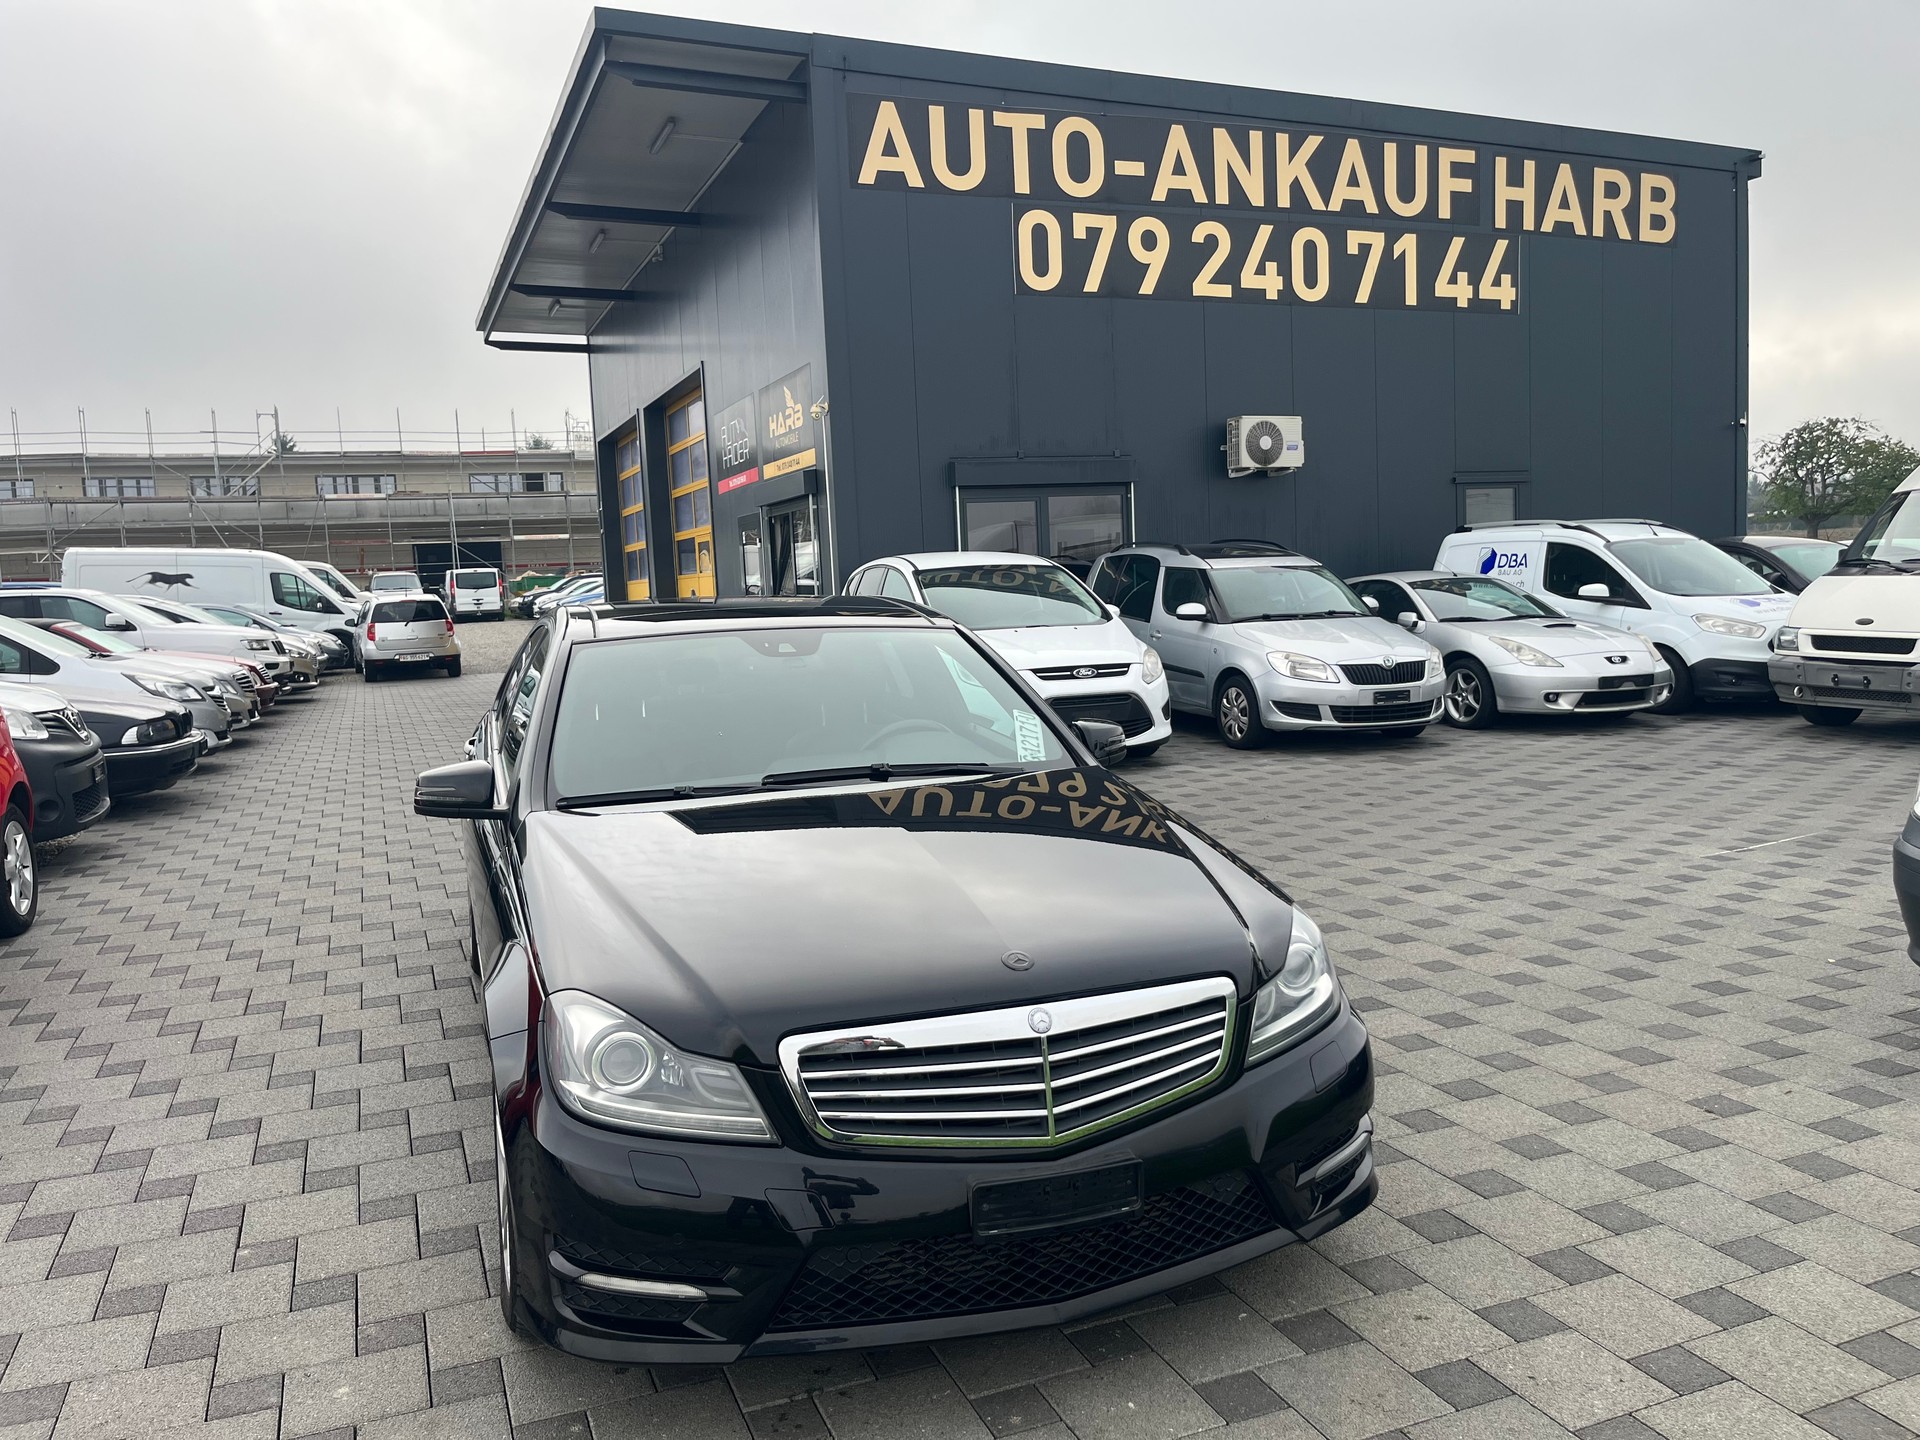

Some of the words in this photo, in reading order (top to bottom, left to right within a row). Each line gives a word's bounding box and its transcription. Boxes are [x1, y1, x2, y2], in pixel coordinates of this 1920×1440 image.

[858, 100, 1475, 219] AUTO-ANKAUF
[1494, 156, 1677, 244] HARB
[1018, 209, 1170, 295] 079
[1191, 220, 1329, 302] 240
[1346, 229, 1417, 306] 71
[1434, 236, 1517, 310] 44
[768, 403, 804, 438] HARB
[1497, 552, 1528, 569] DBA
[1497, 568, 1512, 576] BAU
[1512, 568, 1523, 576] AG
